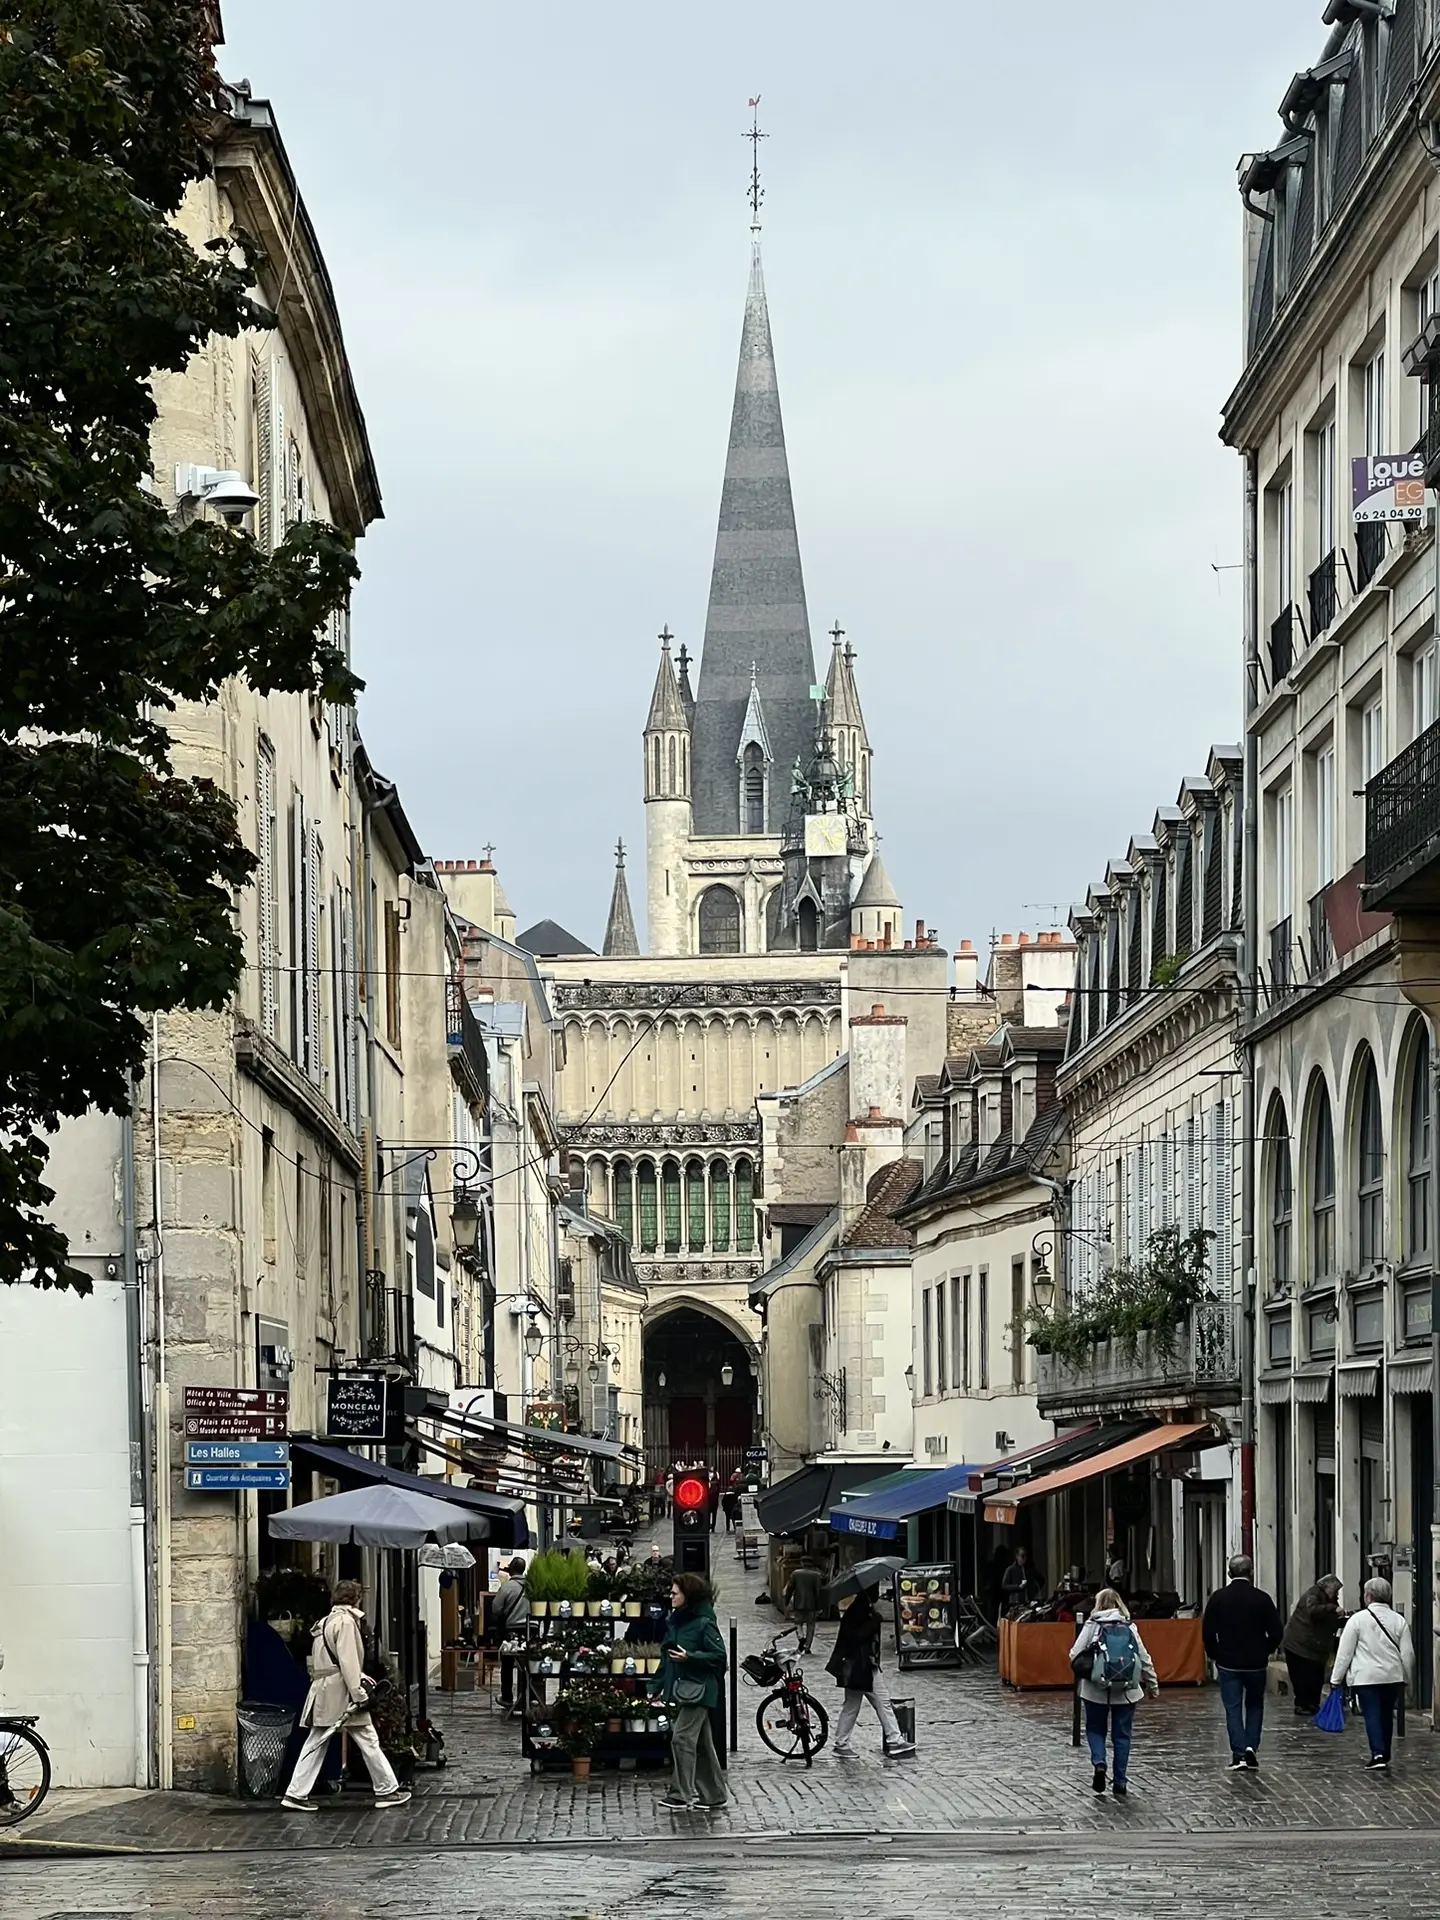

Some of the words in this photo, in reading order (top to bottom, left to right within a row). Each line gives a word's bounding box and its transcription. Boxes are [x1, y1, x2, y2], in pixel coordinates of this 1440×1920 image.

[1368, 453, 1424, 478] loué
[1368, 478, 1392, 491] par
[1396, 482, 1423, 500] EG
[1355, 512, 1368, 521] 06
[1373, 510, 1385, 519] 24
[1390, 509, 1403, 518] 04
[1408, 508, 1421, 517] 90
[186, 1389, 204, 1398] Hôtel
[186, 1399, 206, 1407] Office
[219, 1400, 246, 1408] Tourisme
[330, 1402, 381, 1411] MONCEAU
[199, 1418, 218, 1426] Palais
[220, 1418, 231, 1426] des
[233, 1418, 249, 1426] Ducs
[230, 1426, 261, 1434] Beaux-Arts
[191, 1446, 208, 1458] Les
[210, 1446, 240, 1458] Halles
[205, 1474, 229, 1482] Quartier
[229, 1474, 240, 1482] des
[240, 1474, 272, 1483] Antiquaires
